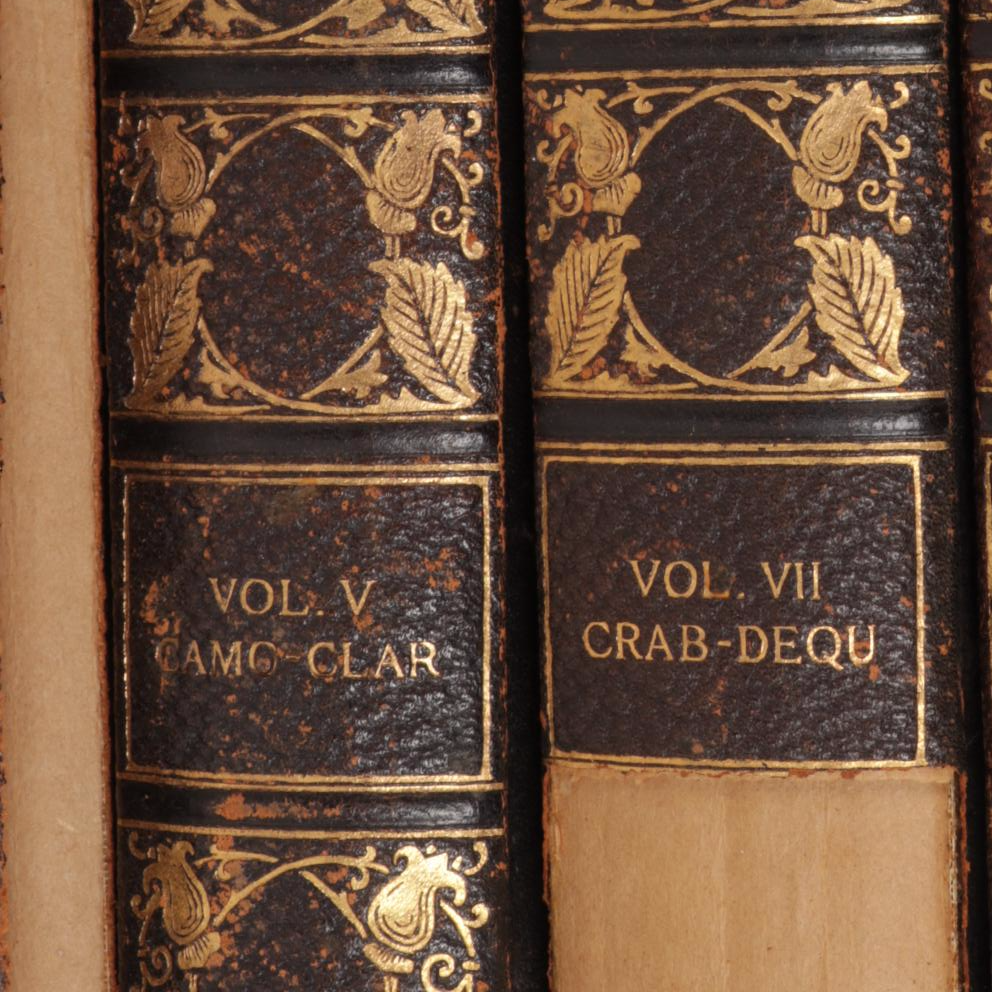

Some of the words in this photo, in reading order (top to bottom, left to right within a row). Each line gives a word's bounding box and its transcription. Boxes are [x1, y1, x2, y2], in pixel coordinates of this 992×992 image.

[209, 578, 324, 616] VOL.
[340, 580, 374, 615] V
[630, 560, 745, 600] VOL.
[761, 561, 821, 600] VII
[582, 621, 876, 671] CRAB-DEQU
